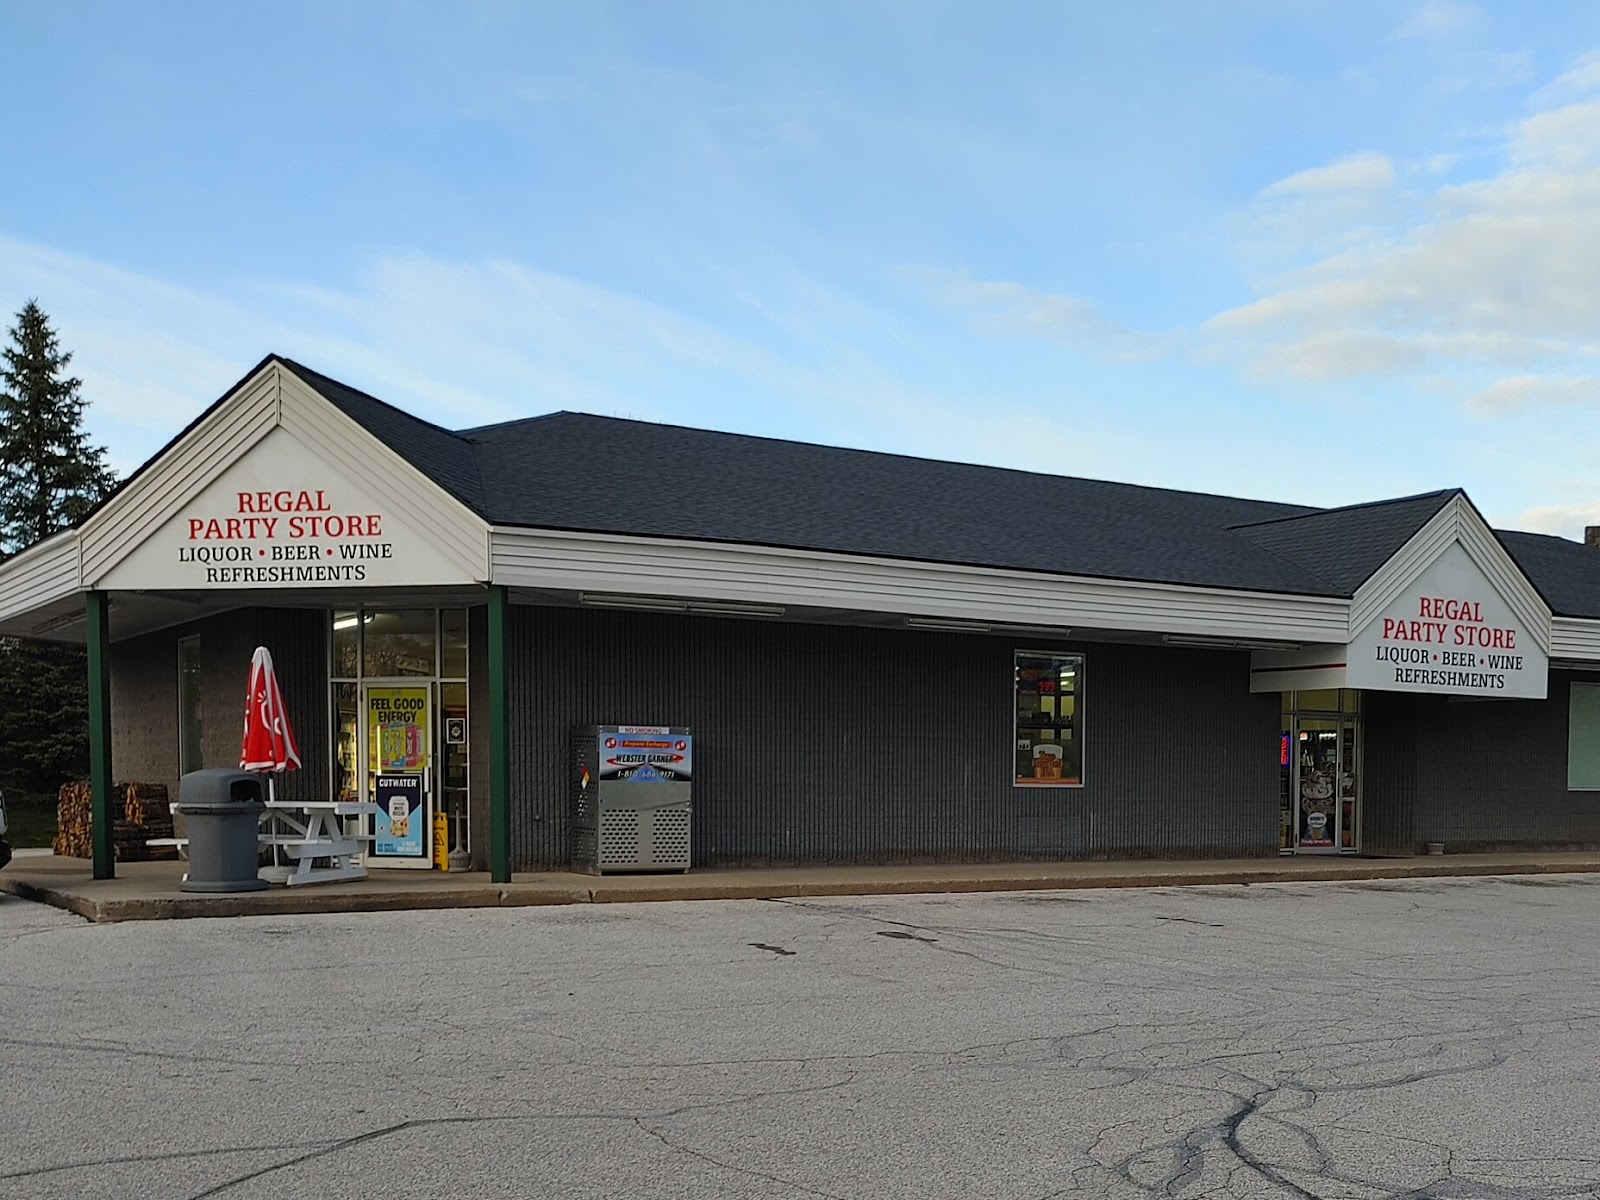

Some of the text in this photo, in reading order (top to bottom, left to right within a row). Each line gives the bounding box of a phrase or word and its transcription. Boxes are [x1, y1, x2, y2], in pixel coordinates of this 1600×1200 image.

[237, 490, 330, 513] REGAL
[188, 515, 382, 540] PARTY STORE
[179, 543, 392, 564] LIQUOR BEER WINE
[206, 565, 366, 583] REFRESHMENTS
[1419, 597, 1484, 622] REGAL
[1382, 618, 1516, 649] PARTY STORE
[1376, 646, 1523, 670] LIQUOR BEER WINE
[1394, 668, 1505, 689] REFRESHMENTS
[371, 698, 424, 710] FEEL GOOD
[378, 711, 417, 723] ENERGY
[616, 754, 674, 763] WEBSTER GARNER
[379, 779, 417, 788] CUTWATER
